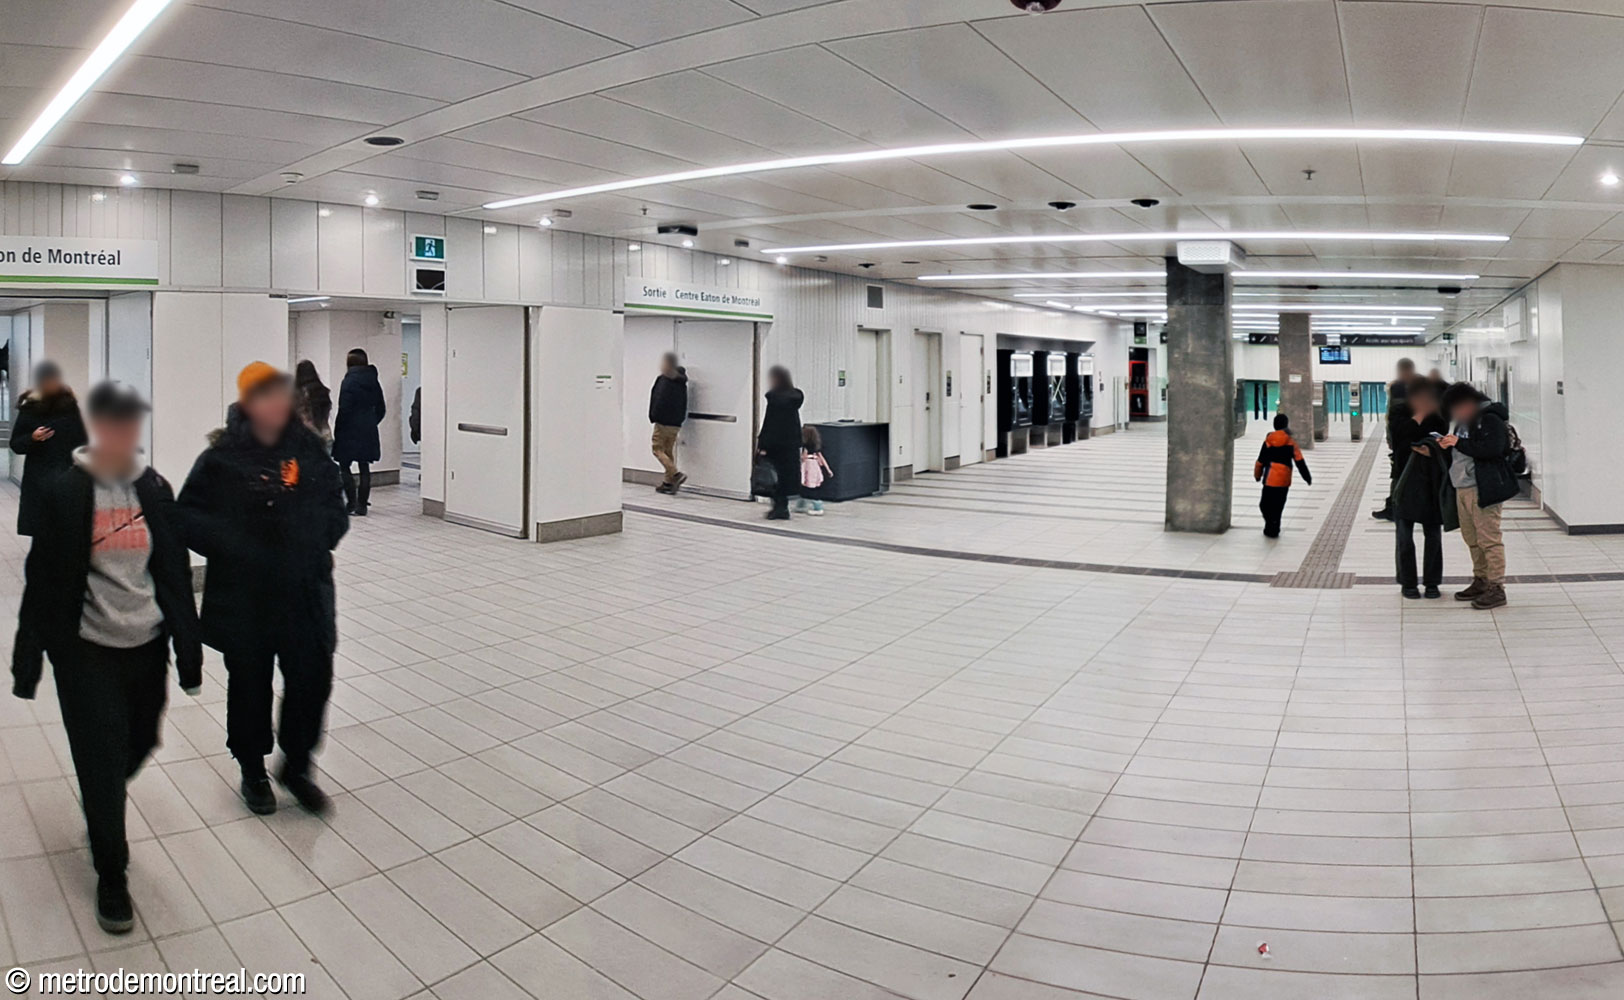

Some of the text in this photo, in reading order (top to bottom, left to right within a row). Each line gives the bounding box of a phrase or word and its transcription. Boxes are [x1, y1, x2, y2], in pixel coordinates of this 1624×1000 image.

[22, 247, 42, 263] de
[48, 249, 121, 265] Montréal
[643, 286, 761, 307] Sortie Centre Eaton de Montréal
